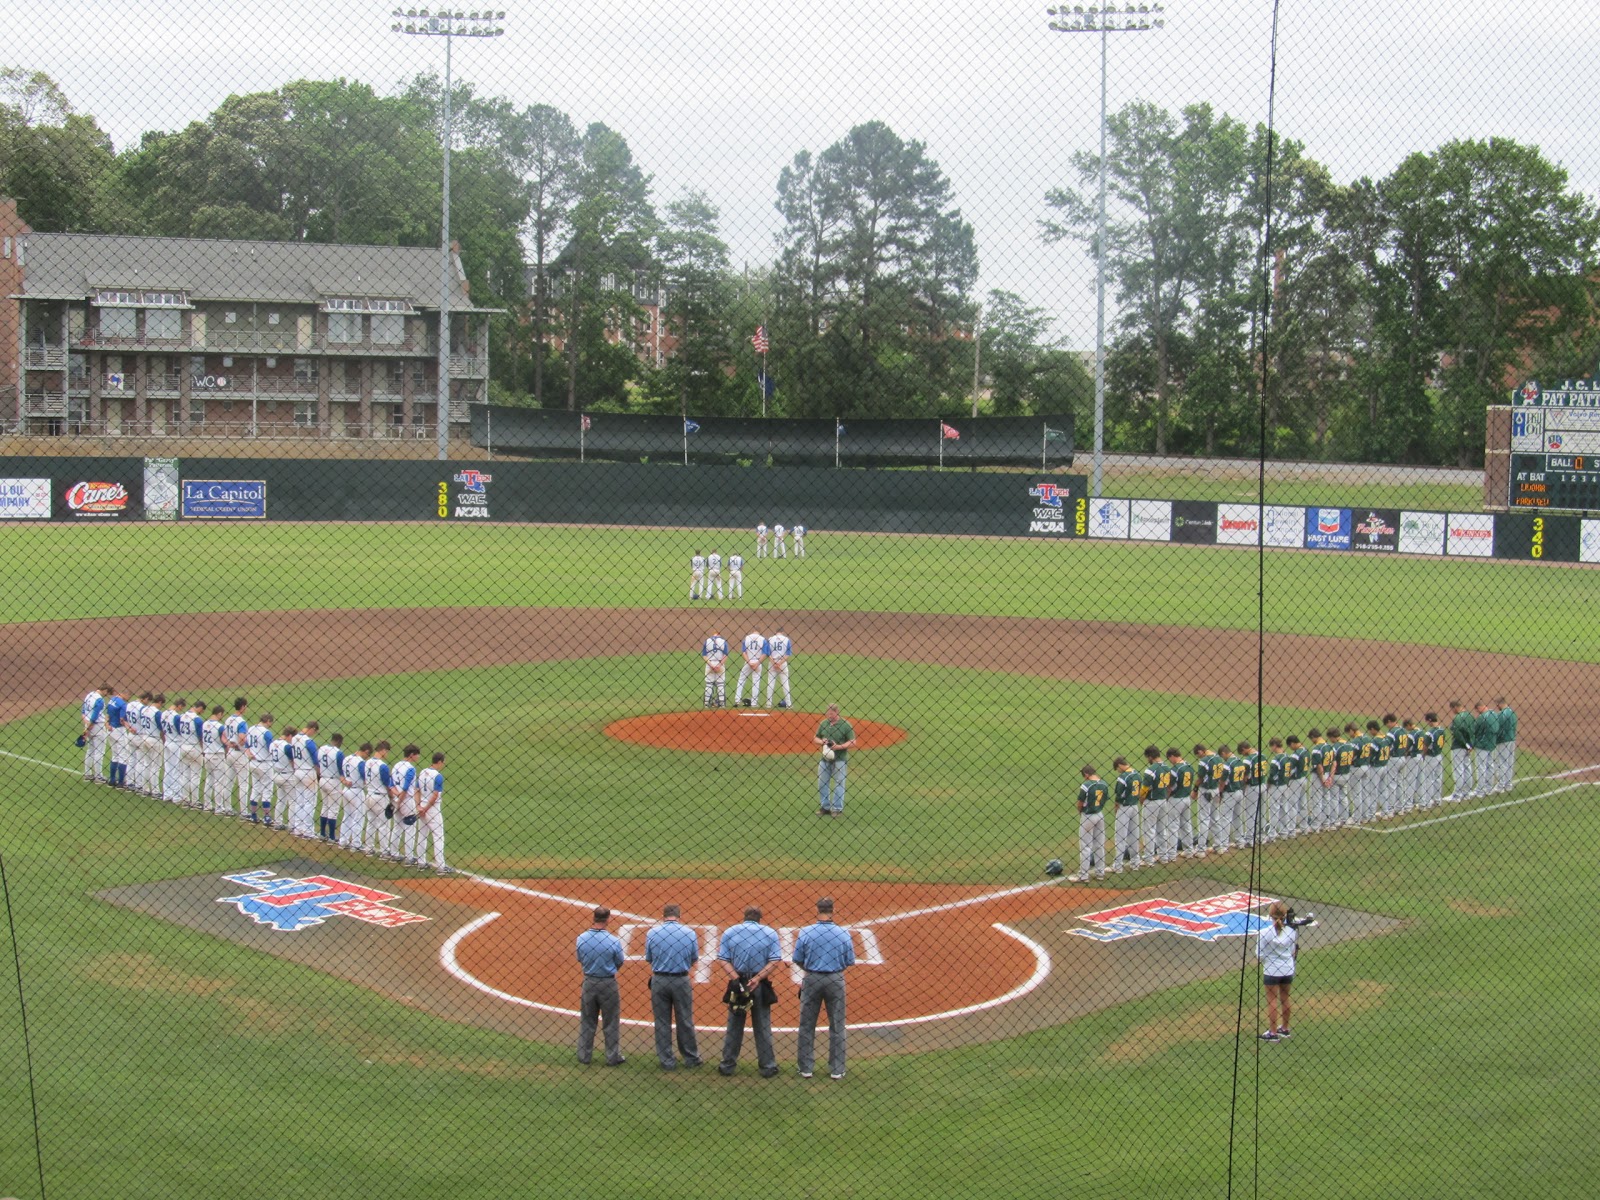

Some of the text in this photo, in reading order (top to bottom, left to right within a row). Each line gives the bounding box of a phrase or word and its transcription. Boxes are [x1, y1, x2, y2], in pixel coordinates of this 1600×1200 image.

[1541, 392, 1566, 406] PAT
[1551, 458, 1572, 467] BALL
[1516, 471, 1546, 482] AT BAT
[68, 481, 128, 510] Cane's
[186, 485, 263, 503] La Capitol
[454, 506, 490, 518] NCAA
[1029, 521, 1066, 532] NCAA
[774, 641, 783, 651] 16
[322, 753, 328, 768] 9
[1131, 780, 1140, 796] 3
[1094, 789, 1104, 806] 7
